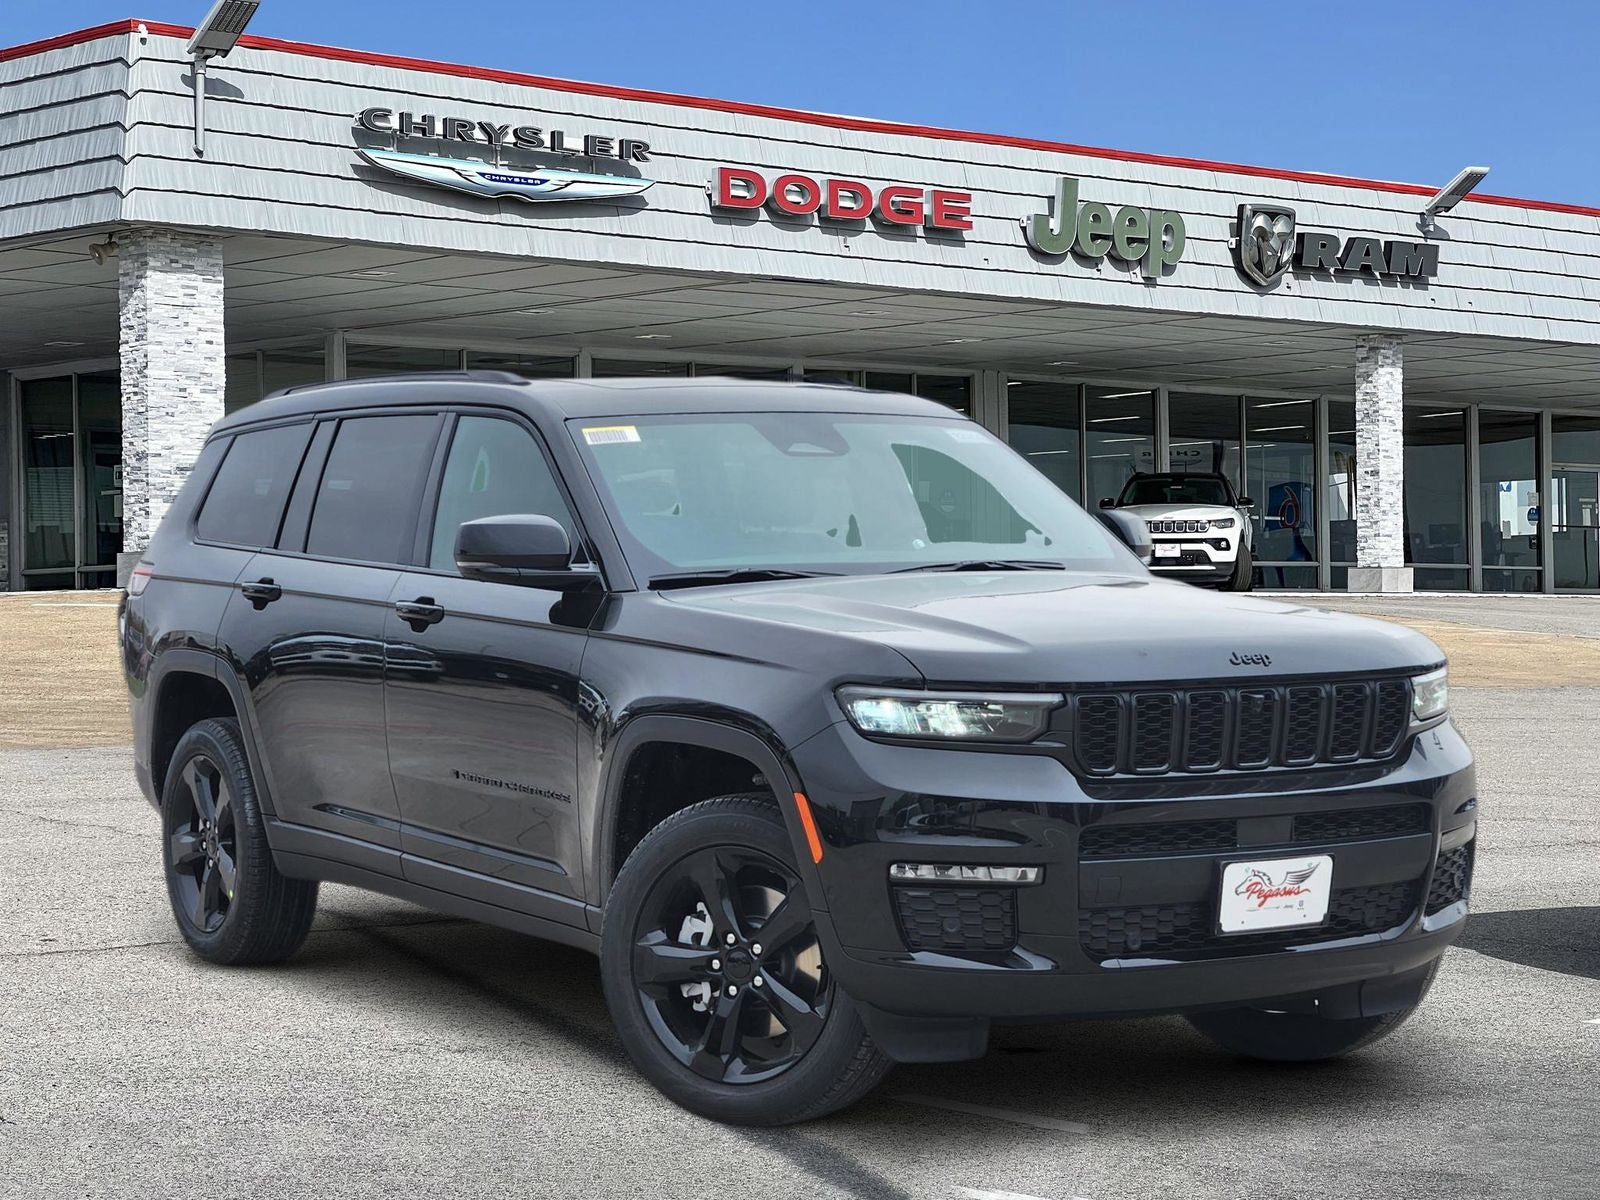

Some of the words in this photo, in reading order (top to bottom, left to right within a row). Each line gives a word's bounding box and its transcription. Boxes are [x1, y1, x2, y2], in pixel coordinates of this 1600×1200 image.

[357, 107, 651, 162] CHRYSLER
[484, 174, 541, 185] CHRYSLER
[712, 167, 973, 230] DODGE
[1027, 177, 1186, 278] Jeep
[1299, 232, 1440, 277] RAM
[1229, 651, 1272, 667] Jeep
[1246, 882, 1311, 908] Pegasus
